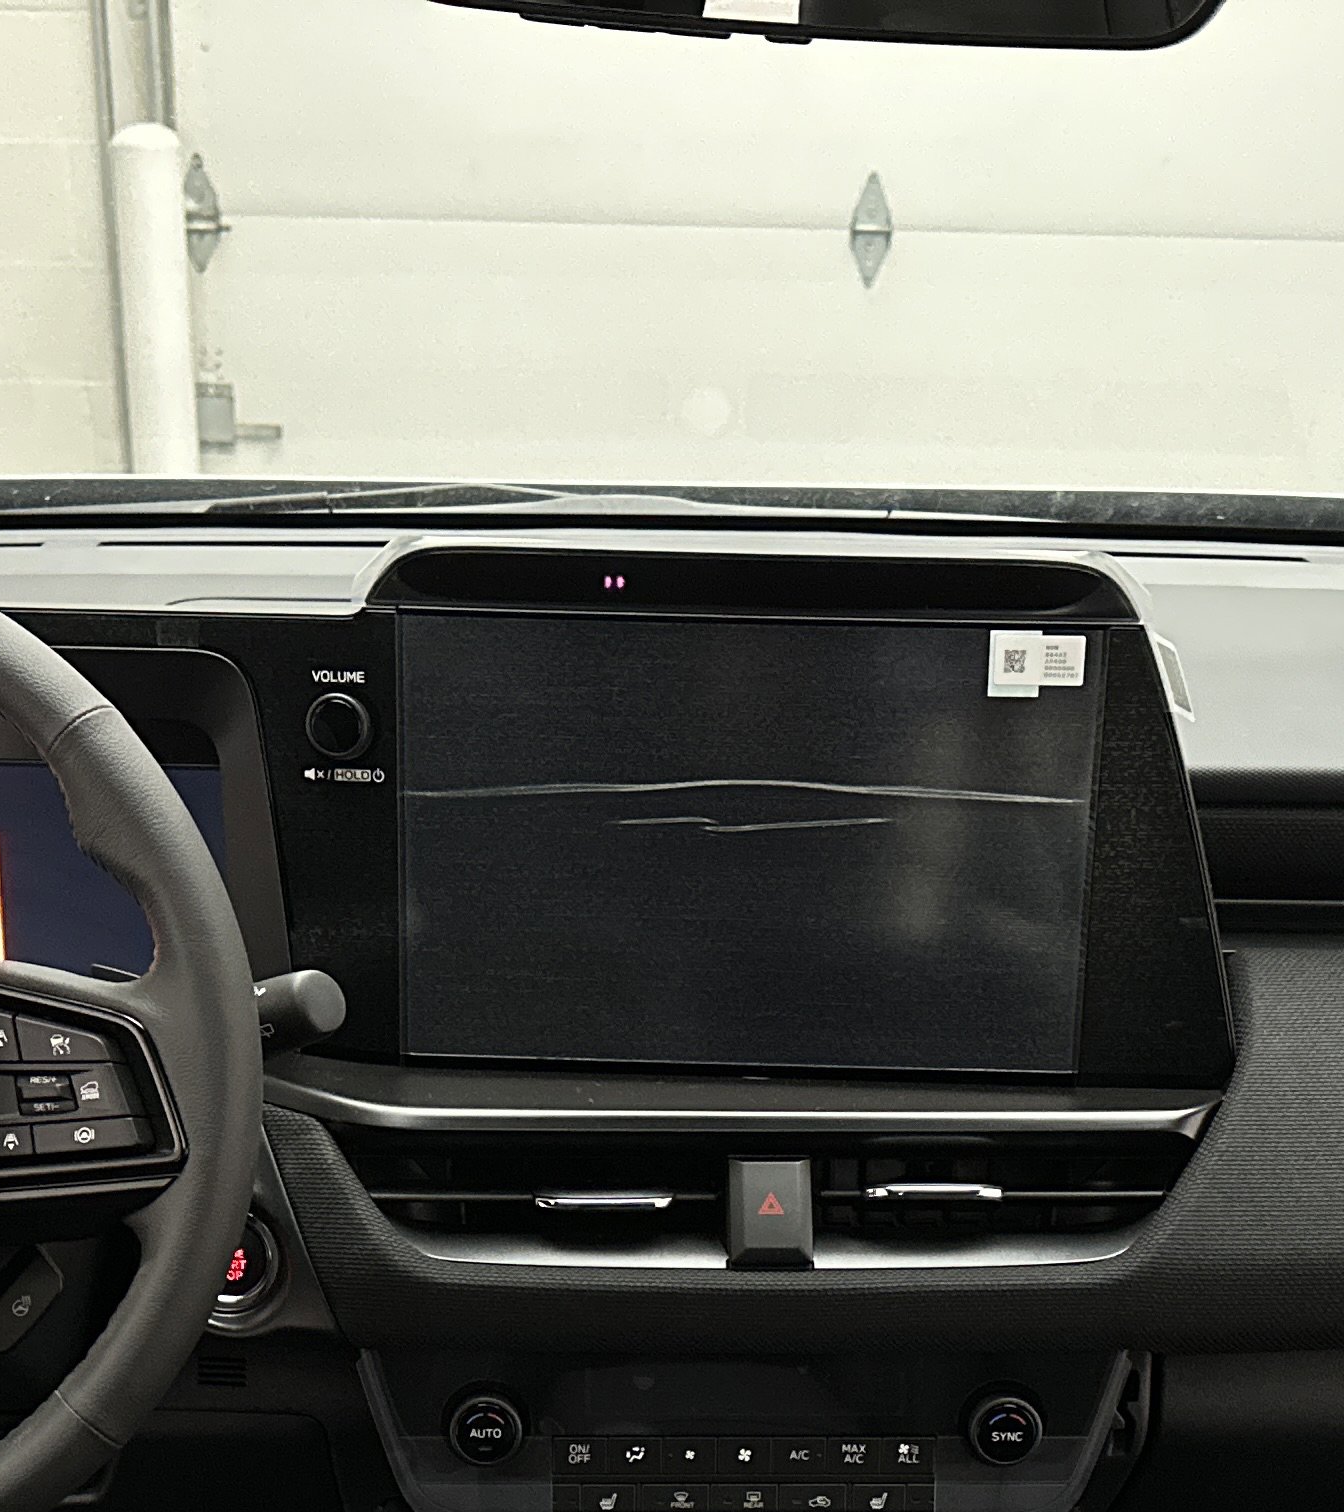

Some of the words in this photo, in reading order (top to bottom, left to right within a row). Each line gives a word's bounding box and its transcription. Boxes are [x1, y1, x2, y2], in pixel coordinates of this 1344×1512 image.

[312, 670, 365, 683] VOLUME
[335, 769, 370, 781] HOLD
[469, 1428, 502, 1439] AUTO
[991, 1432, 1024, 1442] SYNC
[569, 1443, 590, 1454] ON/
[842, 1444, 867, 1454] MAX
[568, 1454, 591, 1464] OFF
[789, 1450, 810, 1461] A/C
[843, 1454, 865, 1464] A/C
[897, 1454, 920, 1464] ALL
[670, 1501, 695, 1509] FRONT
